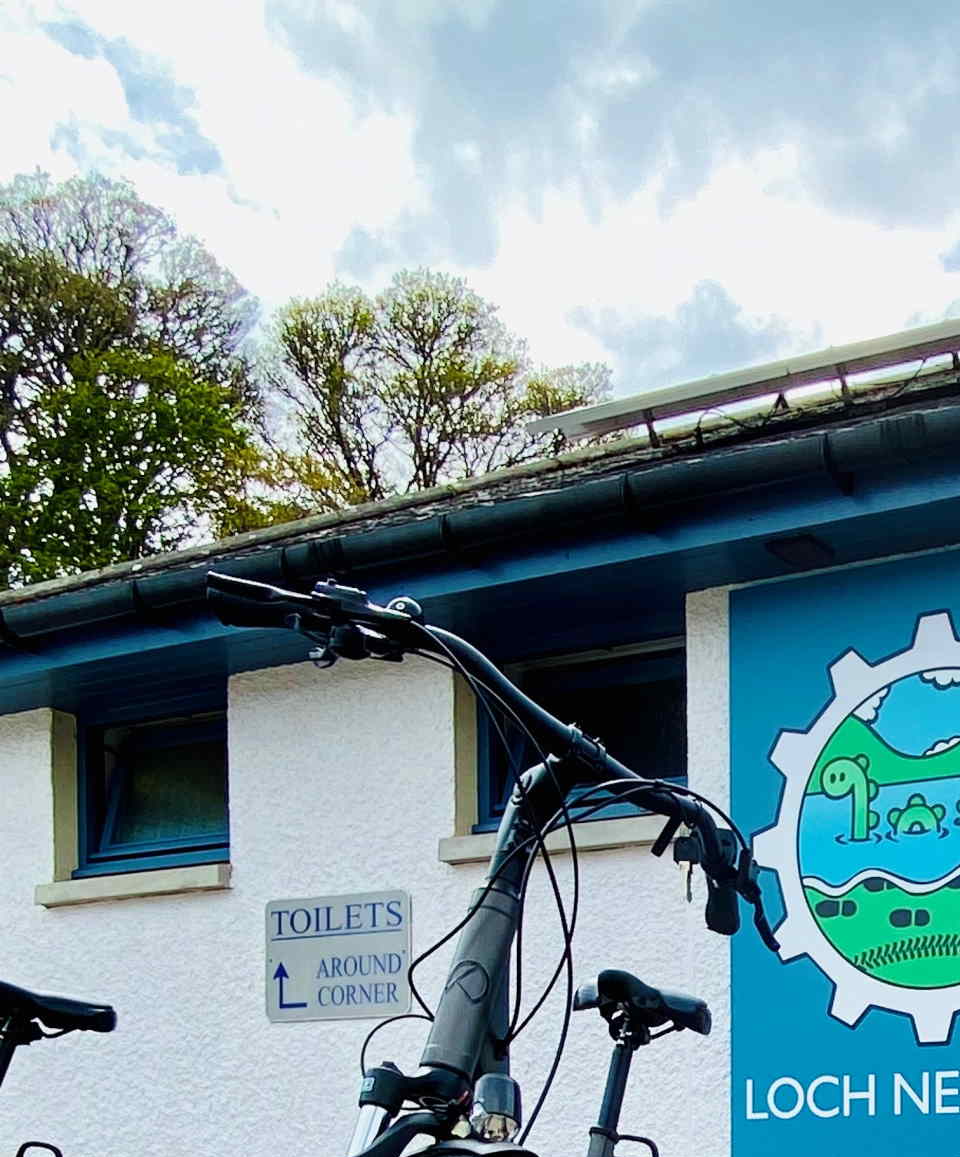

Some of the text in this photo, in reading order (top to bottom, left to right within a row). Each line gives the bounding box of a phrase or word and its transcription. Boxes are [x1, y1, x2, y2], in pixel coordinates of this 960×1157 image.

[271, 900, 403, 936] TOILETS
[316, 953, 401, 979] AROUND
[317, 982, 399, 1007] CORNER
[745, 1074, 876, 1120] LOCH
